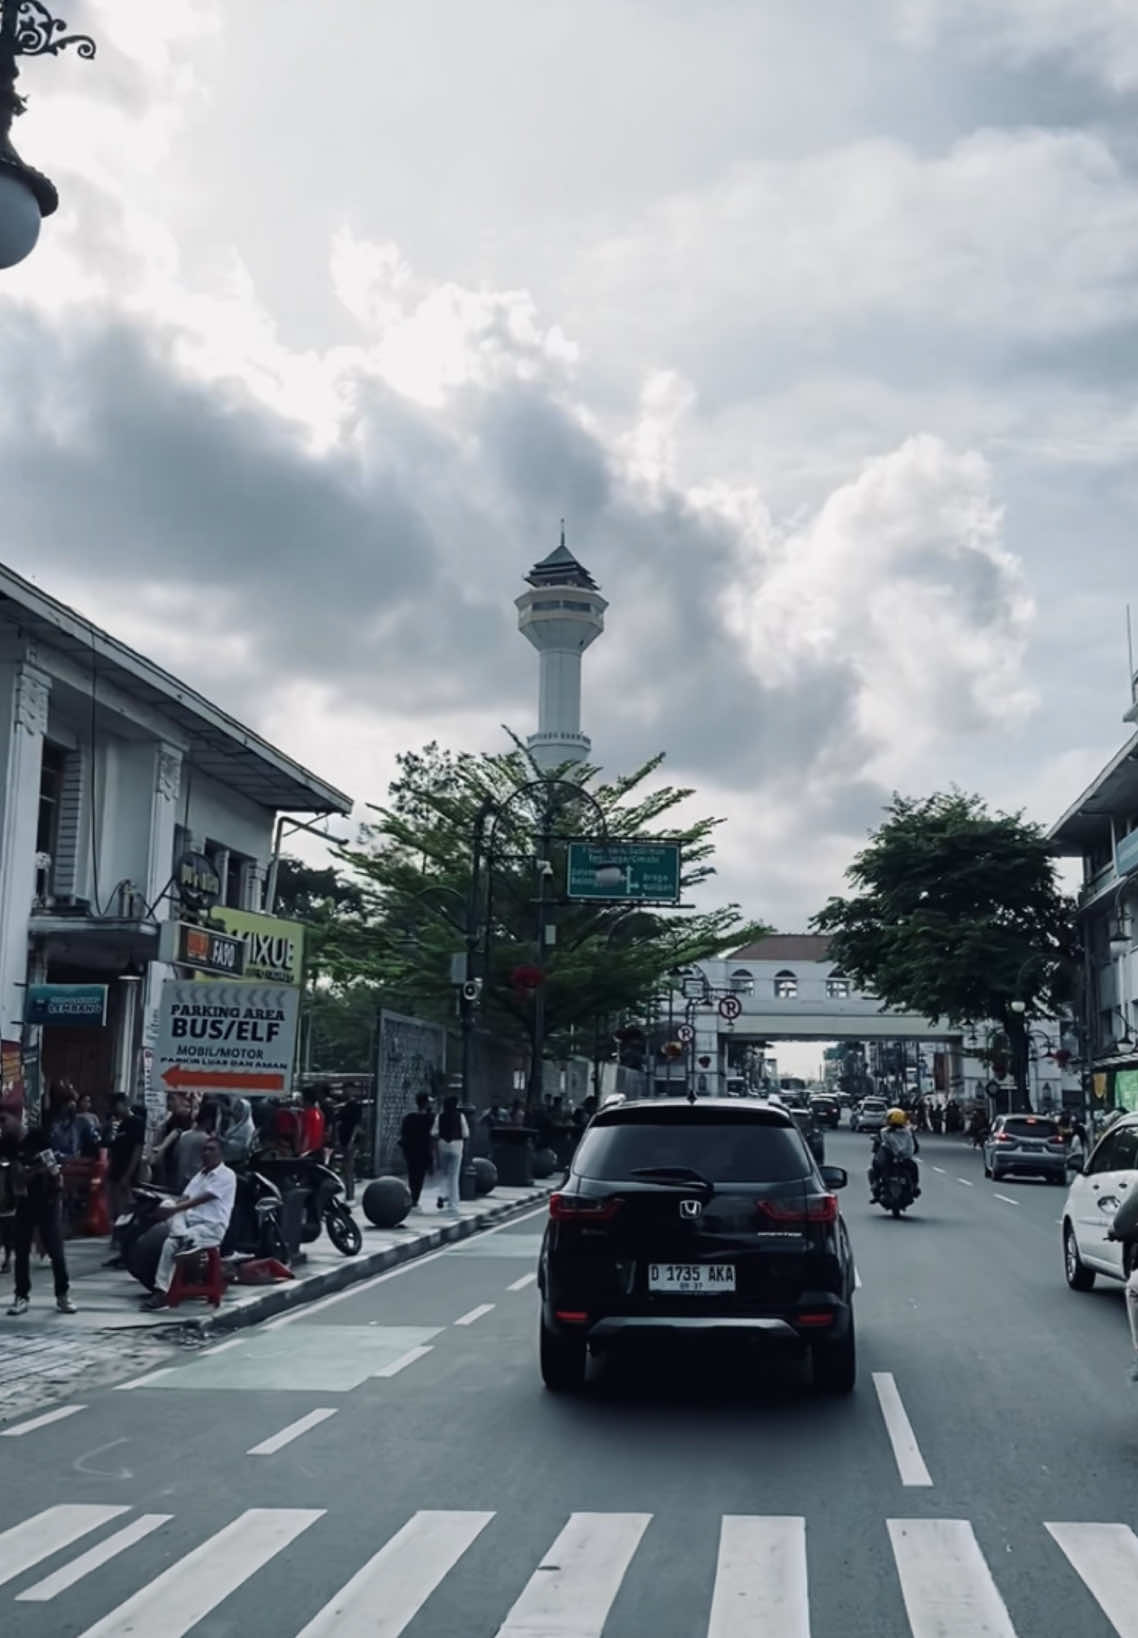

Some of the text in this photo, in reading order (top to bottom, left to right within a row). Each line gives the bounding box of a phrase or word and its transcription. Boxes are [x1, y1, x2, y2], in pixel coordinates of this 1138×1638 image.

[171, 1004, 285, 1021] PARKING AREA
[171, 1018, 280, 1043] BUS/ELF
[176, 1045, 264, 1060] MOBIL/MOTOR
[230, 1060, 254, 1068] DAN
[255, 1062, 288, 1070] AMAN
[651, 1265, 734, 1282] D 1735 AKA
